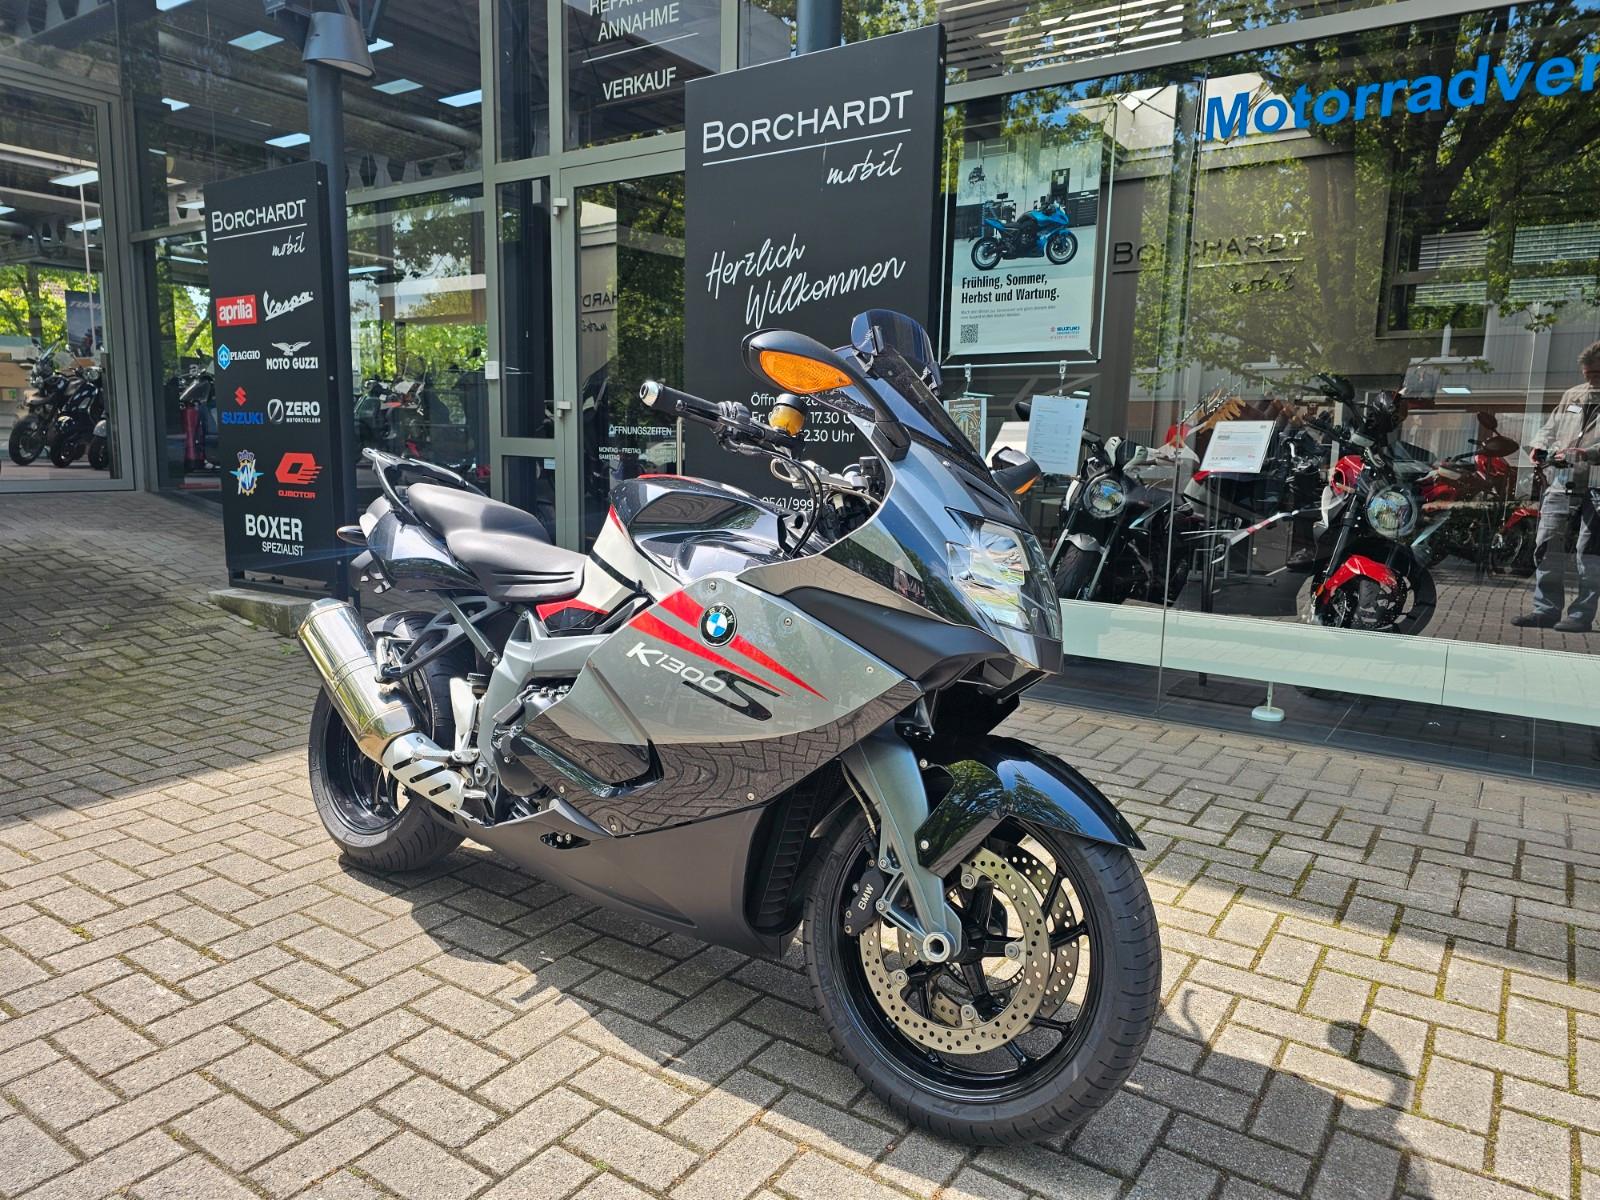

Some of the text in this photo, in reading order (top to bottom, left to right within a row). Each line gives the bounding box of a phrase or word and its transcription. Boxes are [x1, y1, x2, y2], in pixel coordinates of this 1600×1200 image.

[598, 2, 680, 42] ANNAHME
[602, 66, 677, 101] VERKAUF
[702, 90, 914, 154] BORCHARDT
[826, 143, 904, 185] mobil
[211, 199, 307, 233] BORCHARDT
[271, 232, 305, 257] mobil
[706, 233, 806, 300] Herzlich
[745, 256, 907, 330] Willkommen
[961, 273, 1048, 290] Frühling, Sommer,
[262, 290, 314, 322] Vespa
[961, 287, 1060, 304] Herbst und Wartung.
[219, 299, 253, 323] aprilia
[230, 350, 261, 361] PIAGGIO
[266, 356, 319, 370] MOTO GUZZI
[221, 411, 264, 425] SUZUKI
[285, 401, 320, 416] ZERO
[810, 411, 840, 424] 17.30
[832, 430, 855, 442] Uhr
[245, 513, 304, 542] BOXER
[261, 541, 305, 557] SPEZIALIST
[708, 606, 735, 624] BMW
[857, 883, 875, 911] BMW
